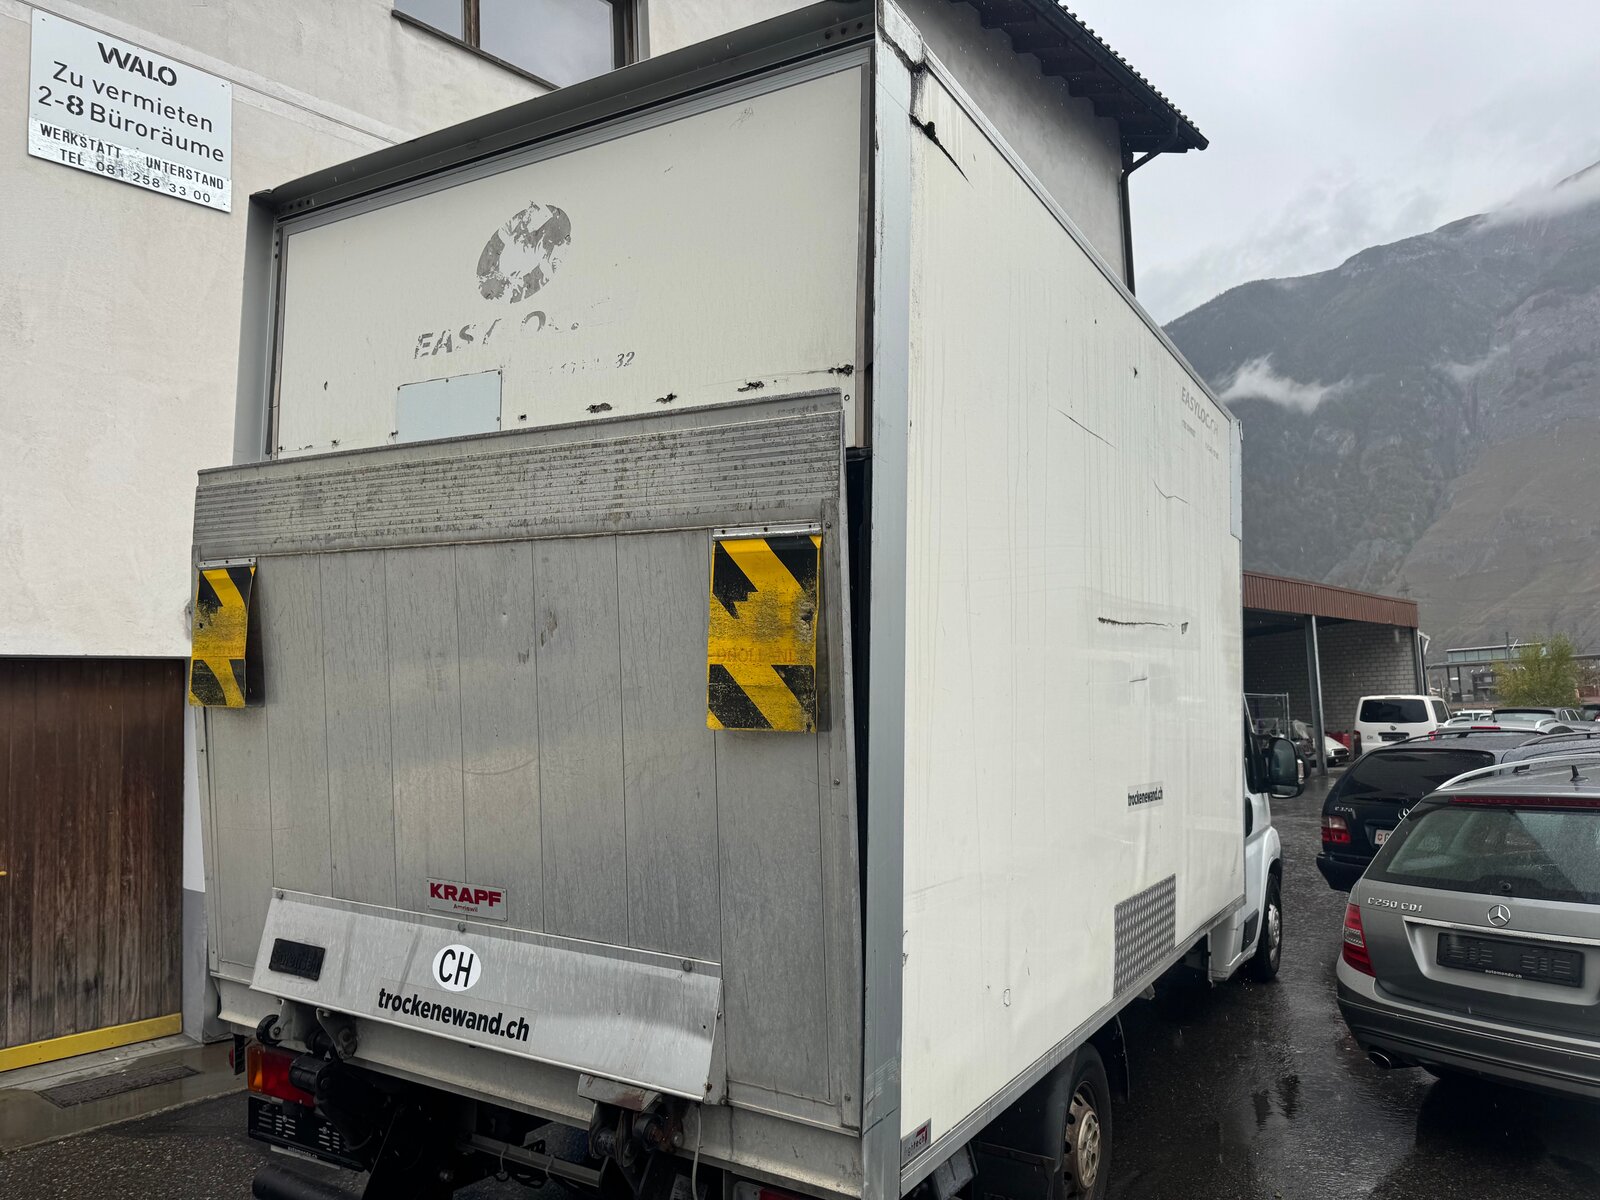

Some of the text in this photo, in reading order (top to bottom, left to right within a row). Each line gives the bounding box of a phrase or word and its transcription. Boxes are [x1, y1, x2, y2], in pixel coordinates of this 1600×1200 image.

[97, 41, 178, 87] WALO
[52, 60, 214, 133] Zu vermieten
[40, 123, 224, 190] WERKSTATT UNTERSTAND
[90, 101, 225, 163] Büroräume
[59, 148, 211, 204] TEL 081 258 33 00
[429, 882, 502, 907] KRAPF
[438, 948, 475, 989] CH
[378, 988, 529, 1042] trockenewand.ch
